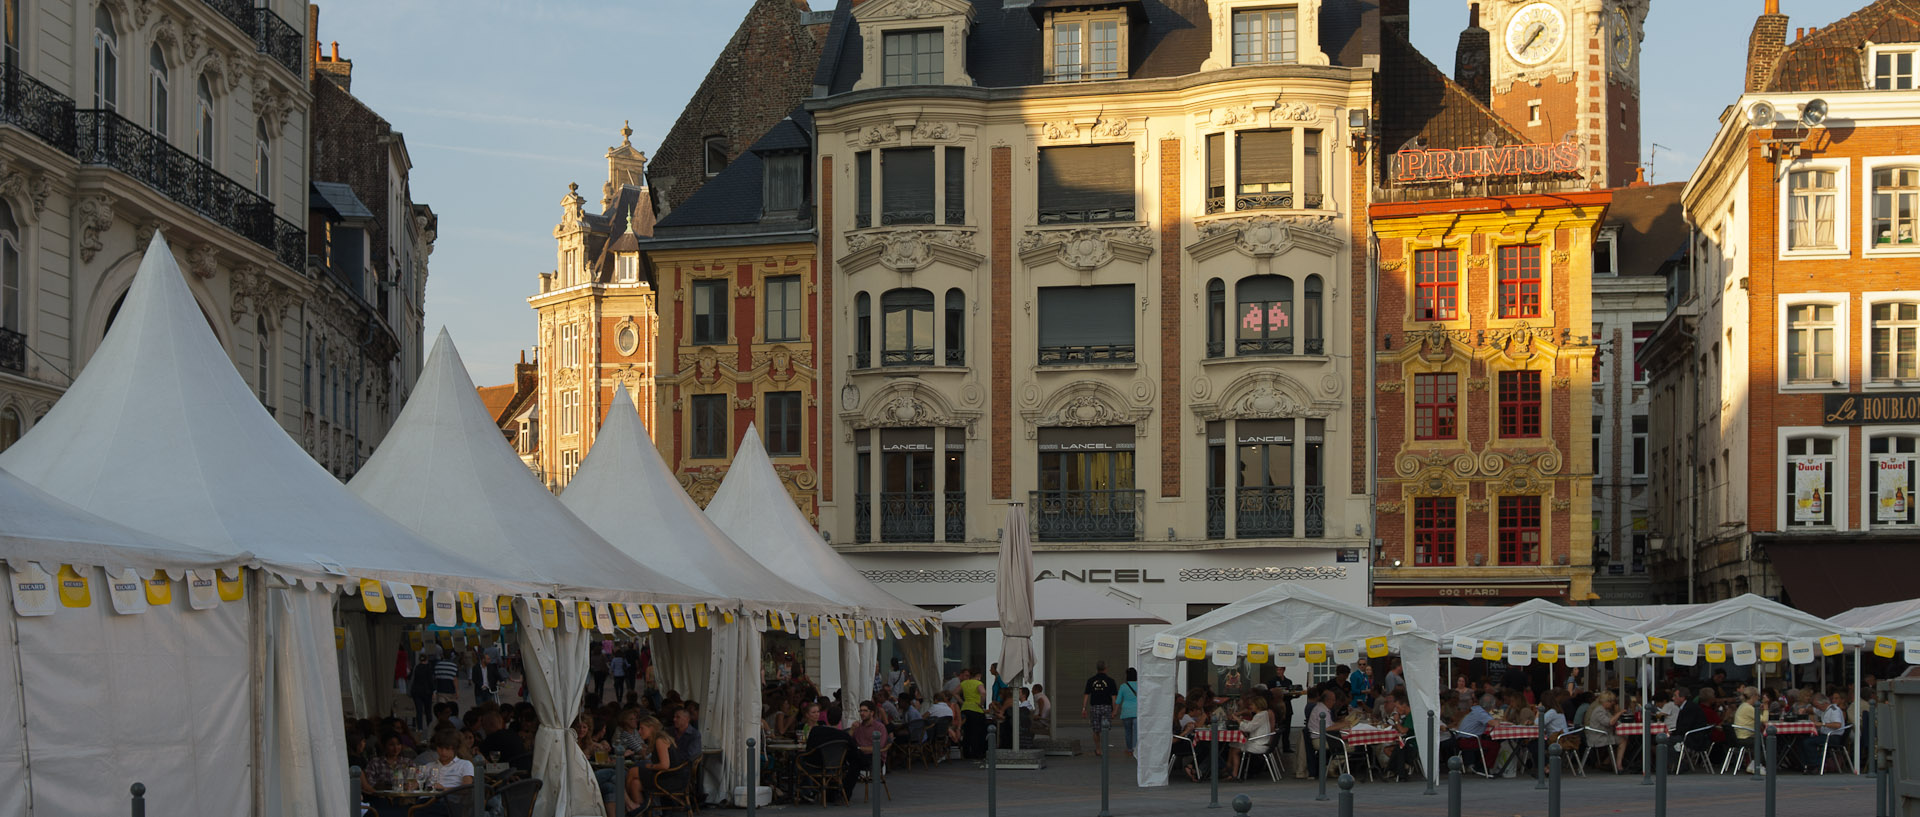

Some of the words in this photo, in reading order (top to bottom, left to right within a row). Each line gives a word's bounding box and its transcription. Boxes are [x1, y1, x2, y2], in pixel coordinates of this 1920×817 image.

[1397, 142, 1580, 181] PRIMUS
[1826, 397, 1857, 422] La
[1798, 462, 1823, 471] Duvel
[1880, 461, 1906, 470] Duvel
[1033, 569, 1165, 583] ANCEL
[1439, 588, 1460, 597] COQ
[1464, 588, 1499, 596] HARDI
